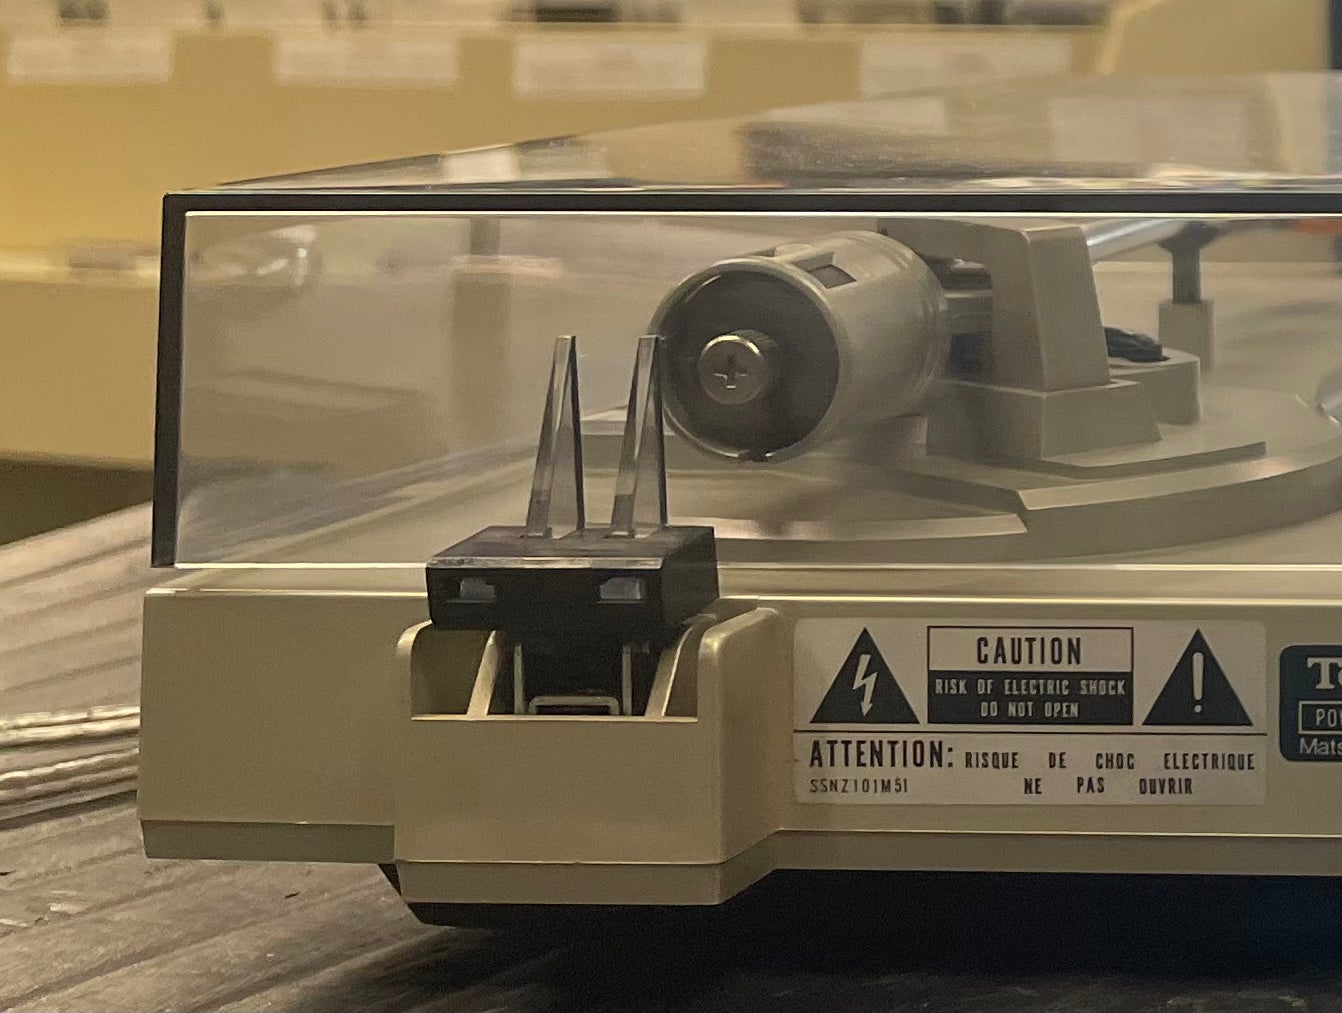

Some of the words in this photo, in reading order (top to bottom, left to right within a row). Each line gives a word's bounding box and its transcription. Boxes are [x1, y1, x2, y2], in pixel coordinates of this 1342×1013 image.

[977, 637, 1081, 665] CAUTION
[935, 679, 967, 695] RISK
[978, 679, 993, 695] OF
[1004, 679, 1069, 695] ELECTRIC
[1081, 680, 1126, 696] SHOCK
[981, 701, 997, 718] DO
[1008, 702, 1037, 718] NOT
[1045, 702, 1079, 718] OPEN
[809, 740, 954, 769] ATTENTION:
[965, 752, 1018, 770] RISQUE
[1049, 752, 1067, 770] DE
[1096, 752, 1135, 770] CHOC
[1164, 752, 1255, 771] ELECTRIQUE
[1024, 778, 1042, 795] NE
[1077, 777, 1105, 794] PAS
[1139, 778, 1193, 795] OUVRIR
